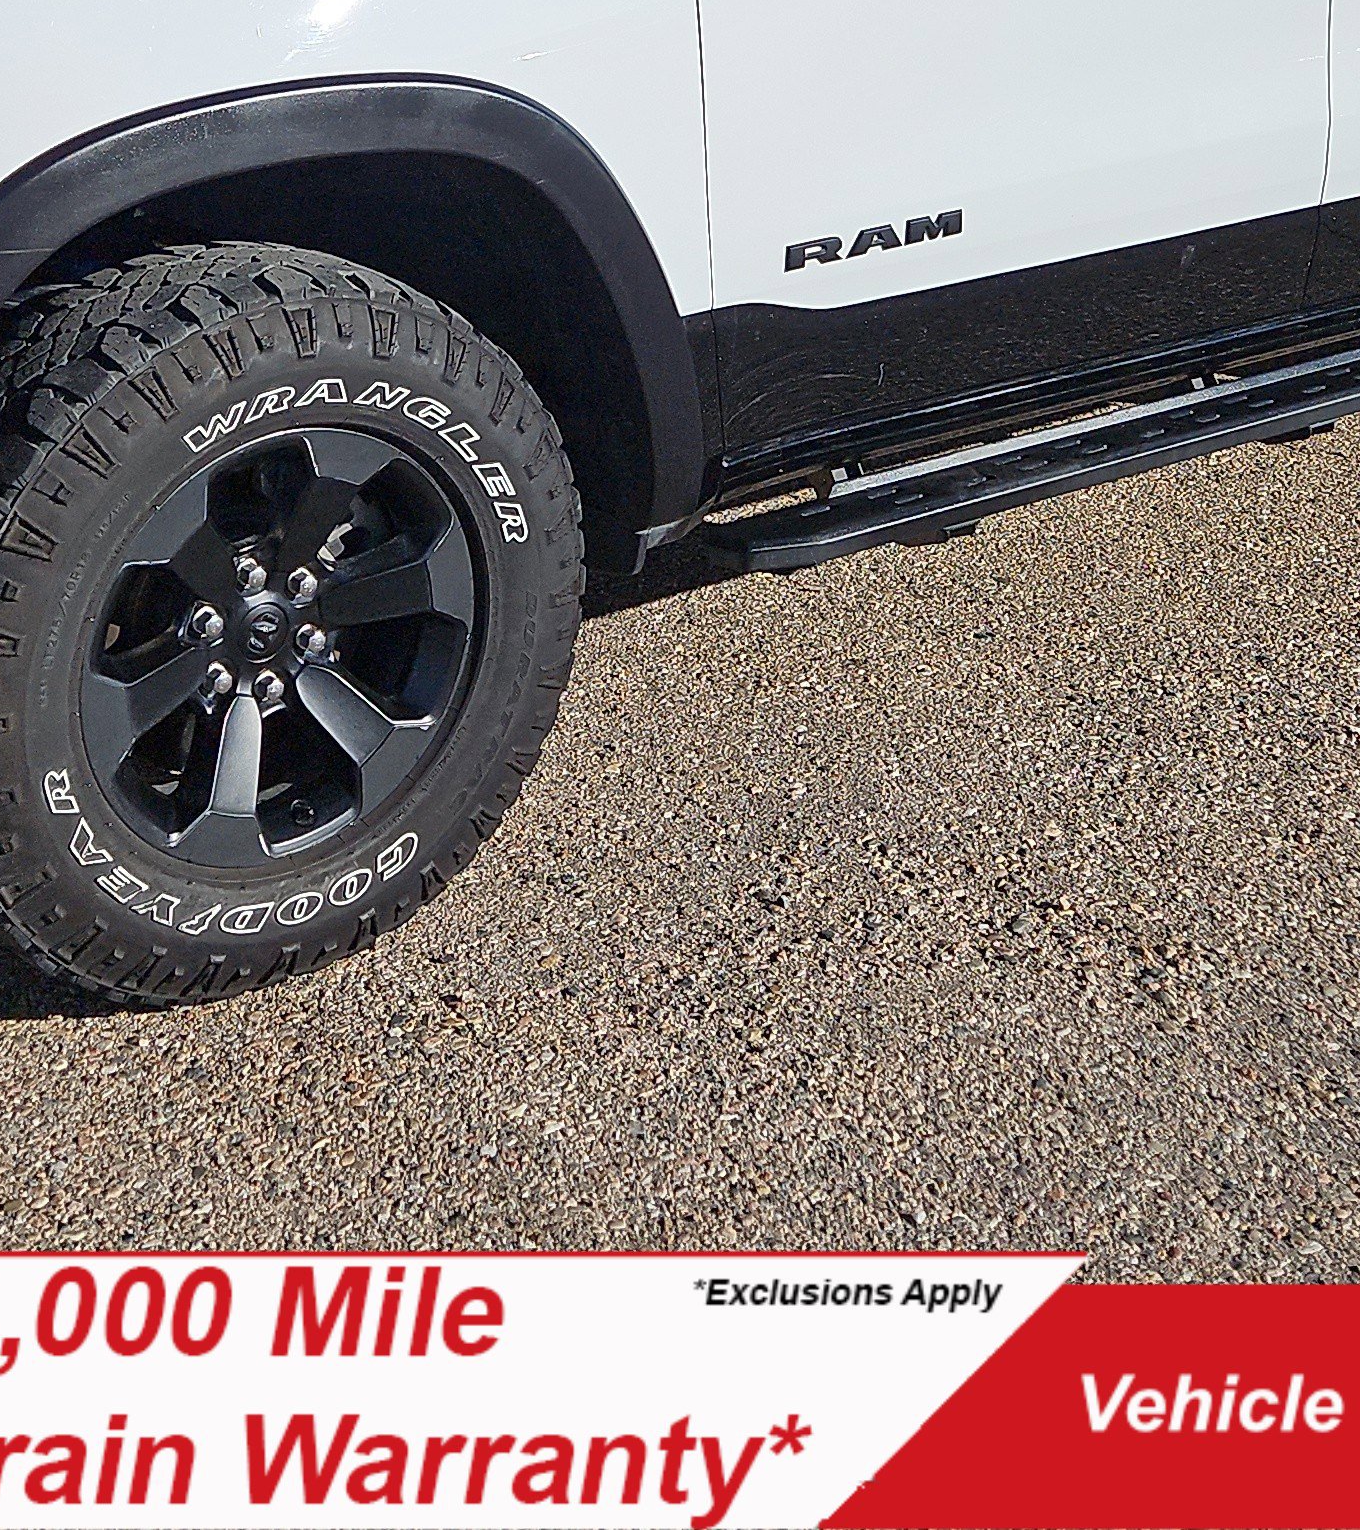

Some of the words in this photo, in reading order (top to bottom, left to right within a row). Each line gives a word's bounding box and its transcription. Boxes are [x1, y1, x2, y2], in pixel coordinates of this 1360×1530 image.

[784, 208, 963, 273] RAM
[182, 378, 529, 545] WRANGLER
[42, 768, 419, 936] GOODYEAR
